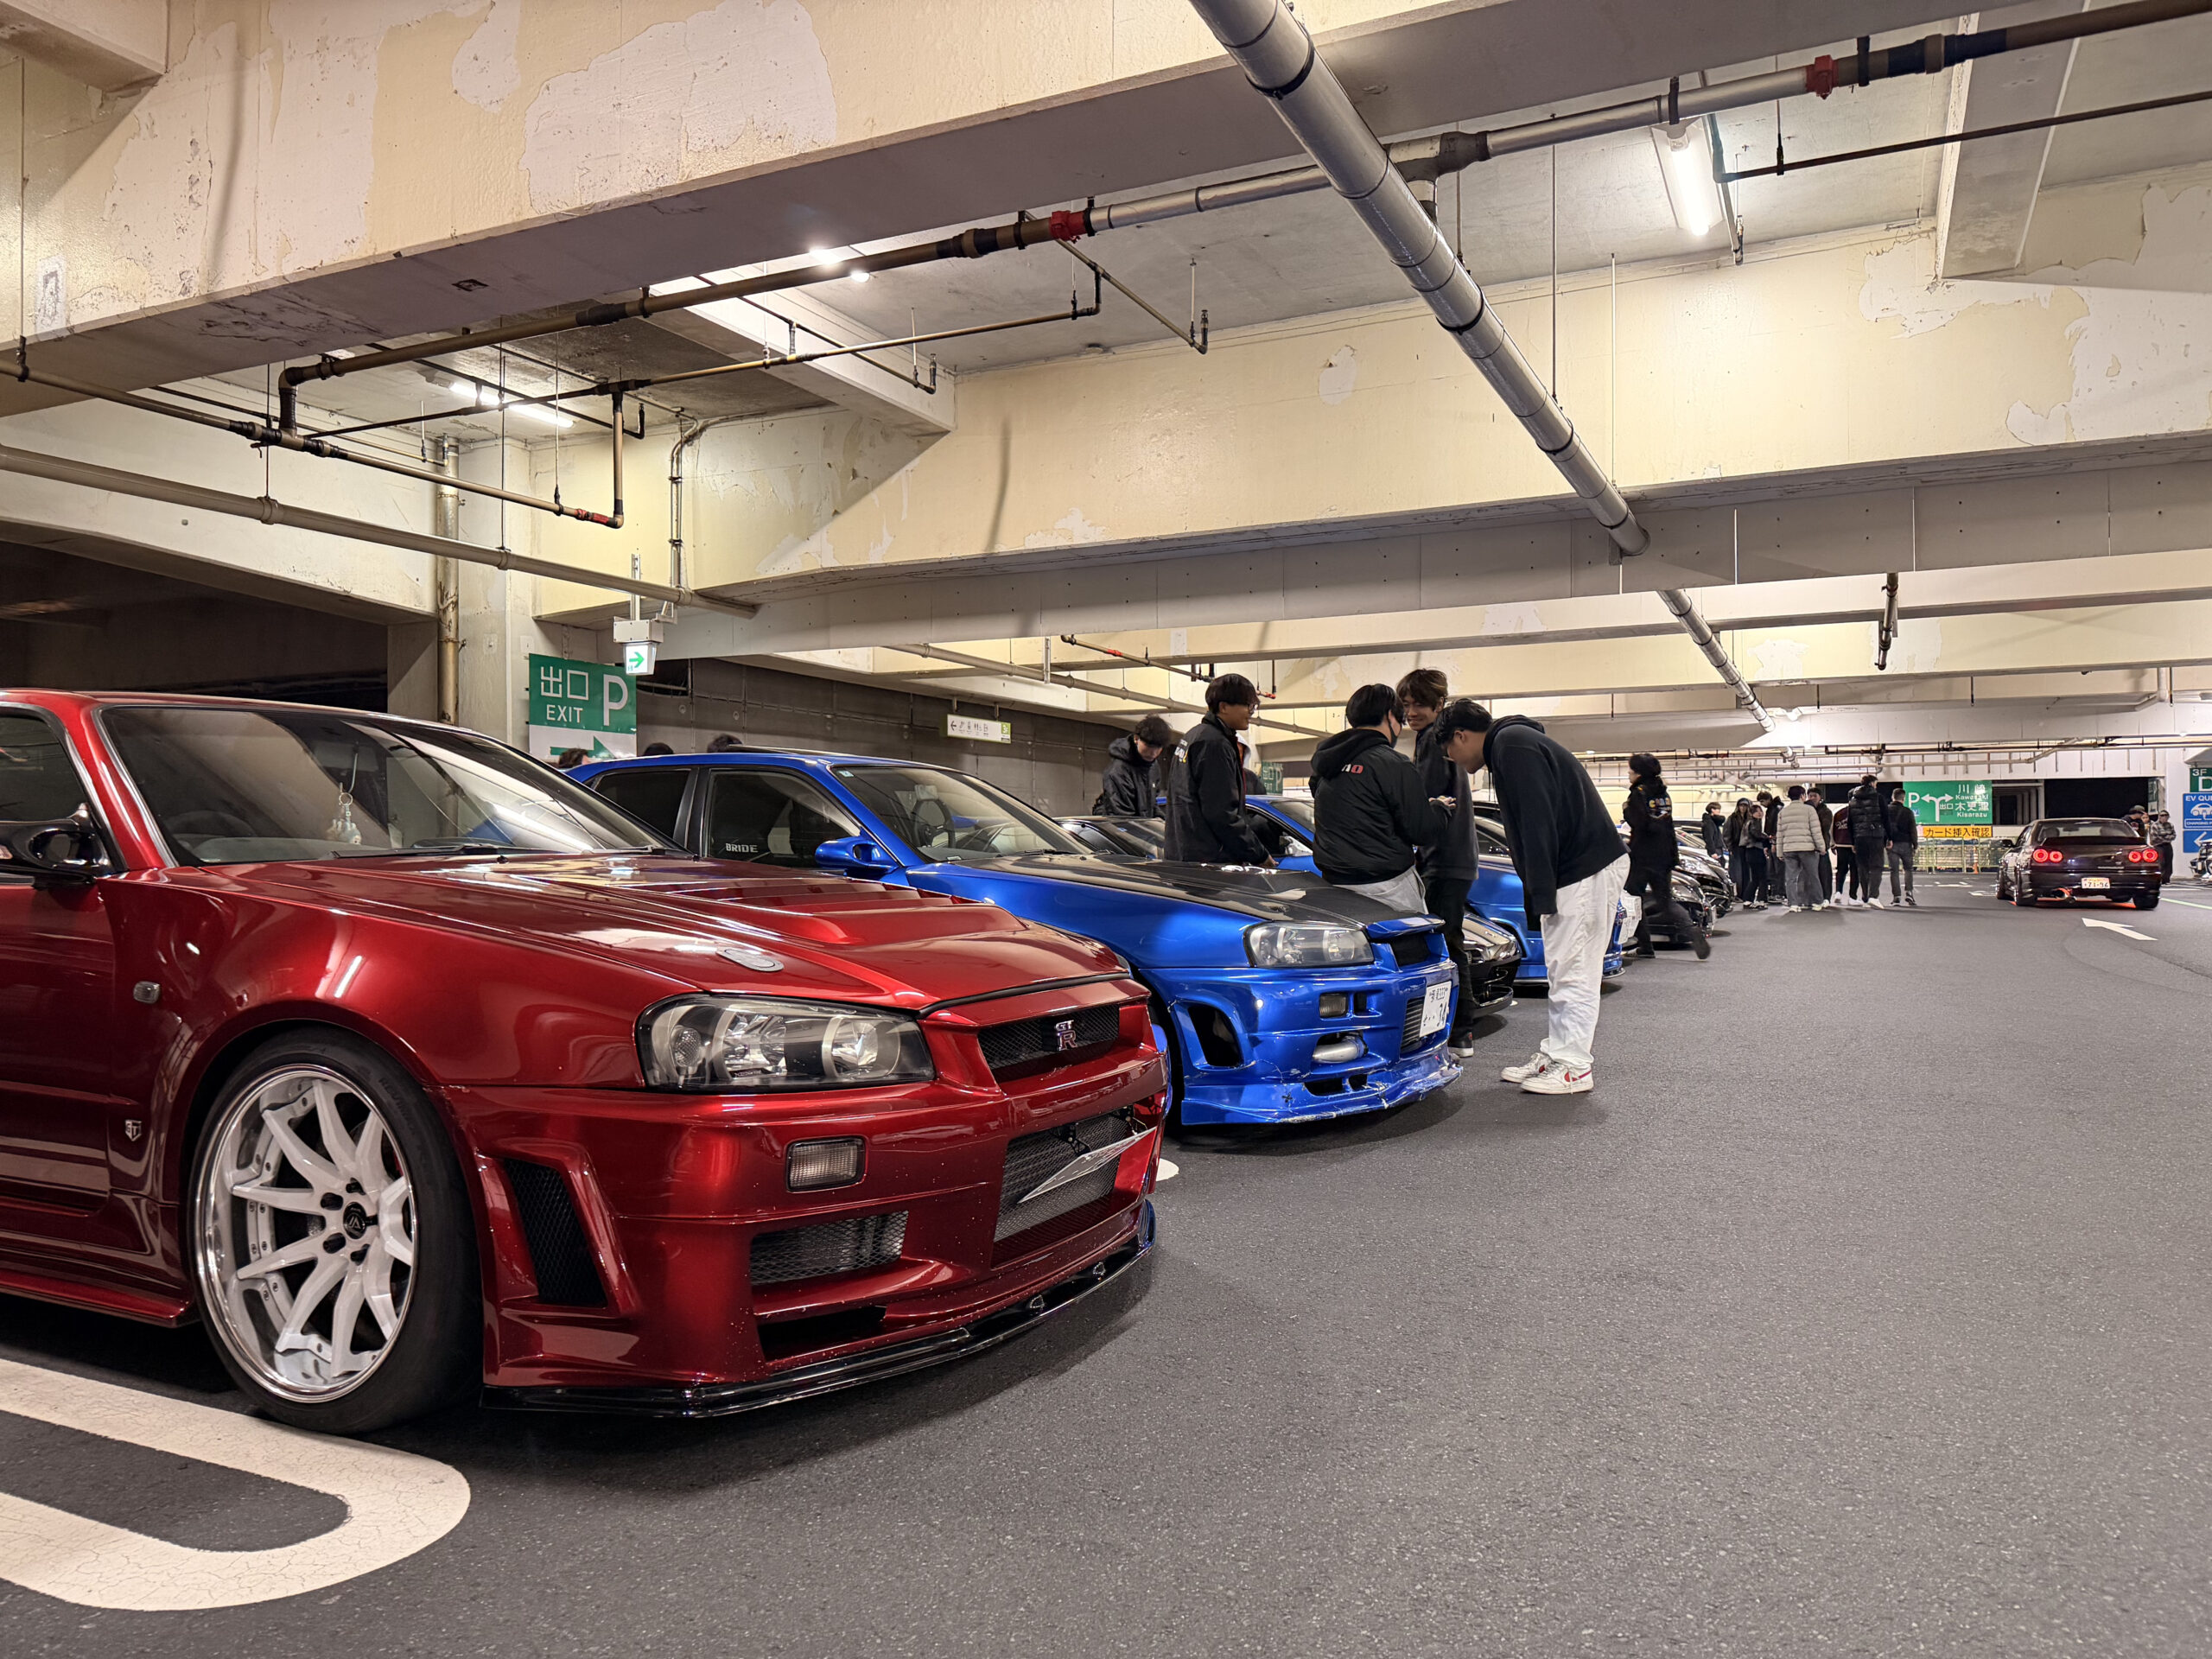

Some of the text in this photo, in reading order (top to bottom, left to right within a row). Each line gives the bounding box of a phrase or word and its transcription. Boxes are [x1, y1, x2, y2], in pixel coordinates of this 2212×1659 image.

[541, 666, 588, 701] 出口
[603, 674, 628, 726] P
[546, 704, 583, 723] EXIT
[1908, 792, 1921, 808] P
[1955, 801, 1989, 811] 木更津
[1927, 827, 1990, 837] カード挿入確認
[726, 843, 759, 853] BRIDE
[1056, 1020, 1074, 1032] GT
[1057, 1030, 1078, 1051] R
